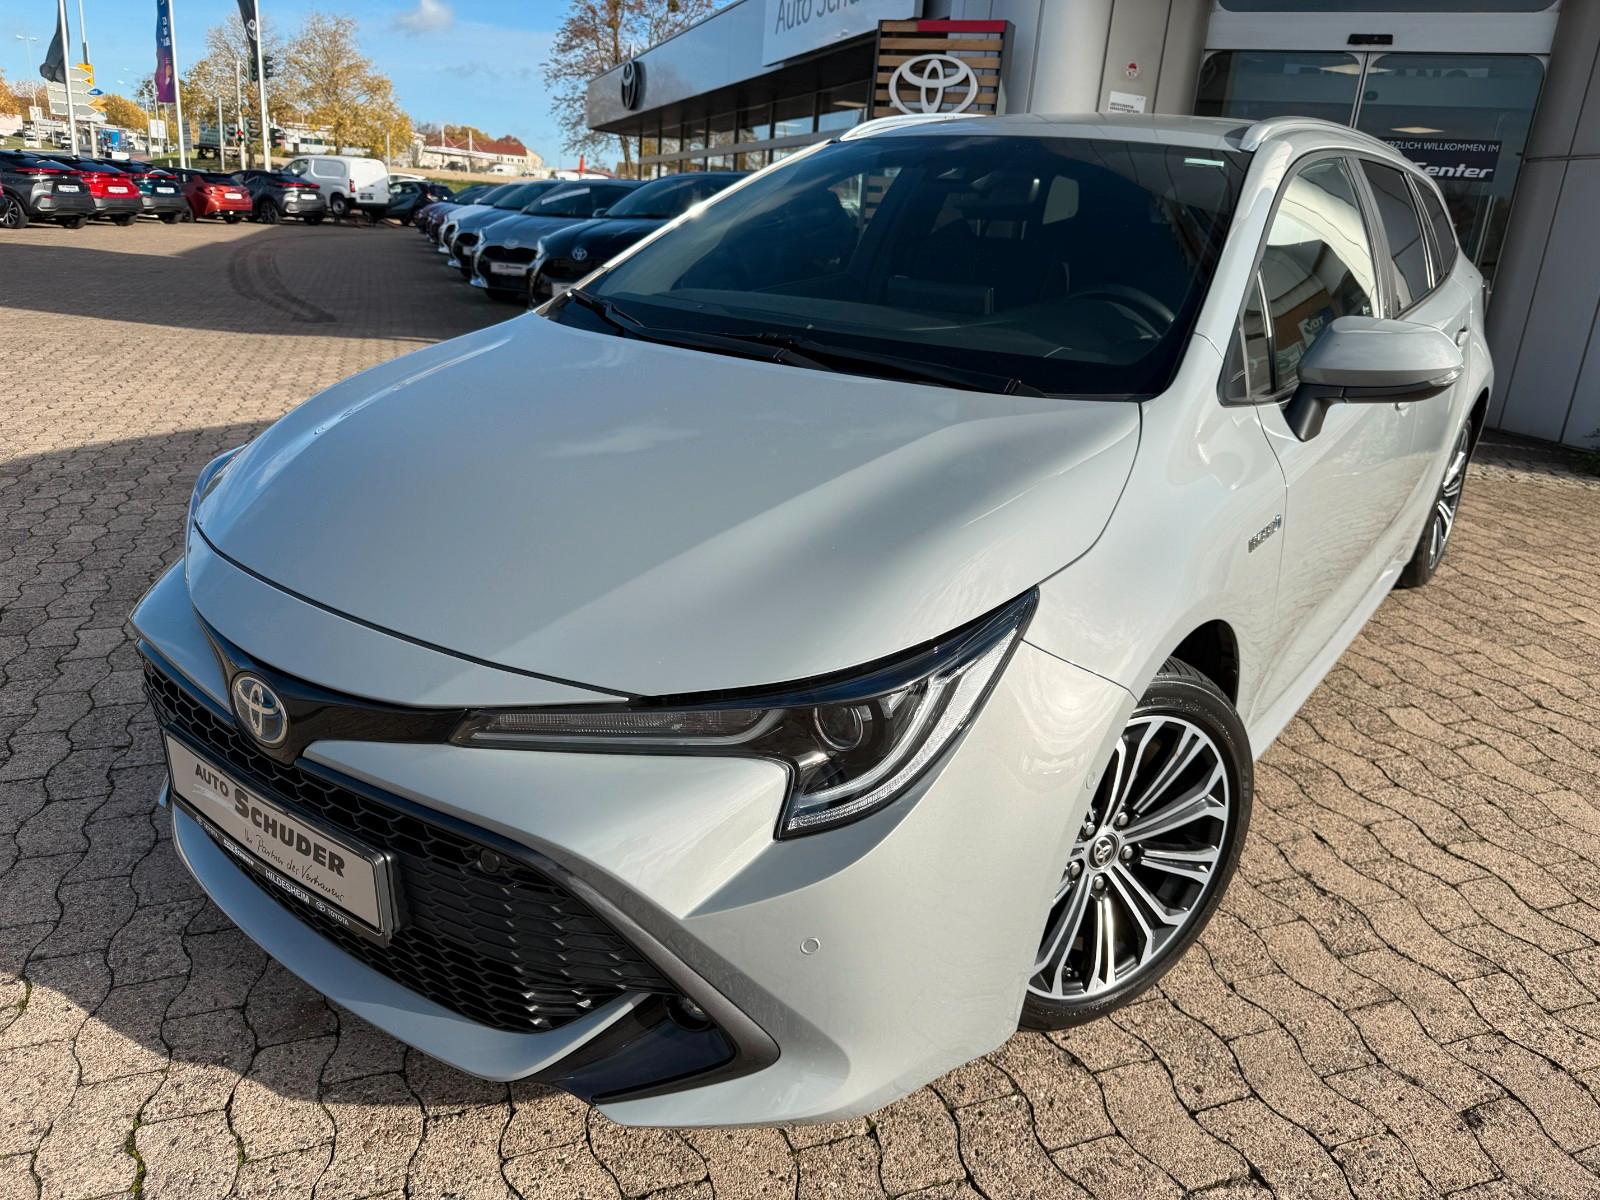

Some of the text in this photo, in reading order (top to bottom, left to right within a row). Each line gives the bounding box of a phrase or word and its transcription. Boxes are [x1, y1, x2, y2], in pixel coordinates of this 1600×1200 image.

[775, 0, 812, 35] Auto
[1384, 140, 1499, 152] RZLICH WILLKOMMEN IM
[195, 763, 229, 797] AUTO
[234, 788, 345, 878] SCHUDER
[265, 869, 350, 927] HILDESHEIM TOYOTA
